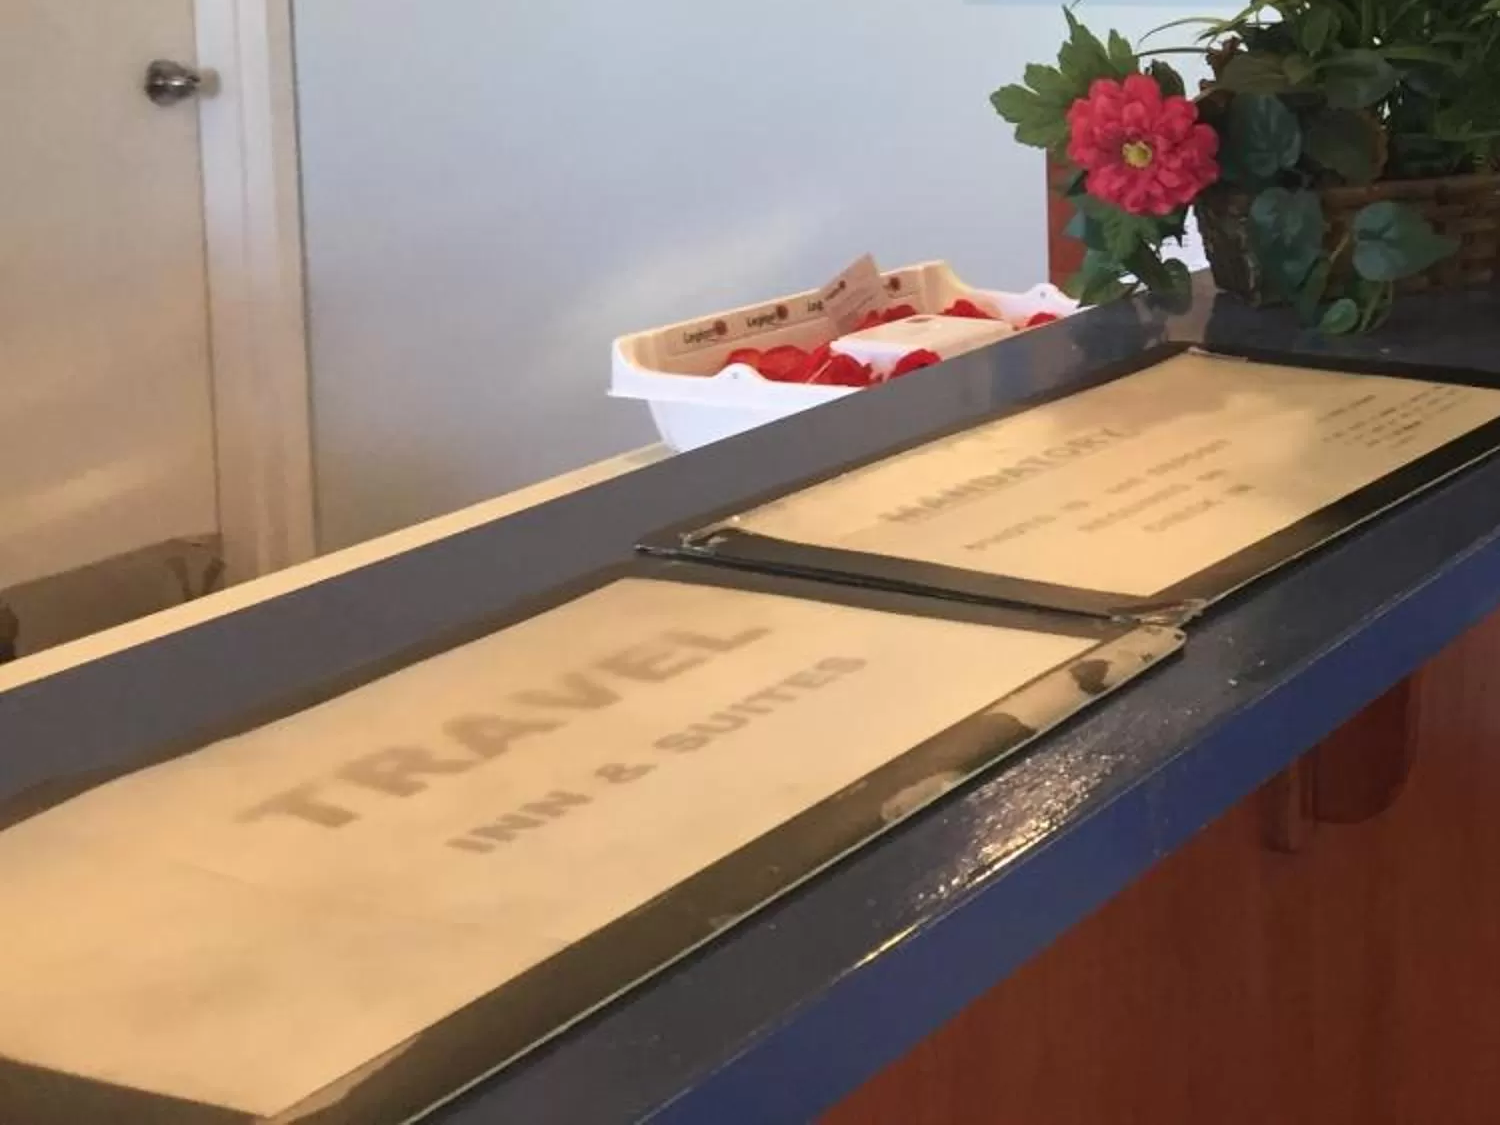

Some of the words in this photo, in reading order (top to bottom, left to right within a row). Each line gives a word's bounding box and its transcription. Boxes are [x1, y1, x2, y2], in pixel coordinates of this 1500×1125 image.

[879, 427, 1127, 523] MANDATORY
[238, 625, 774, 830] TRAVEL
[447, 789, 592, 855] INN
[594, 762, 655, 785] &
[655, 655, 868, 755] SUITES
